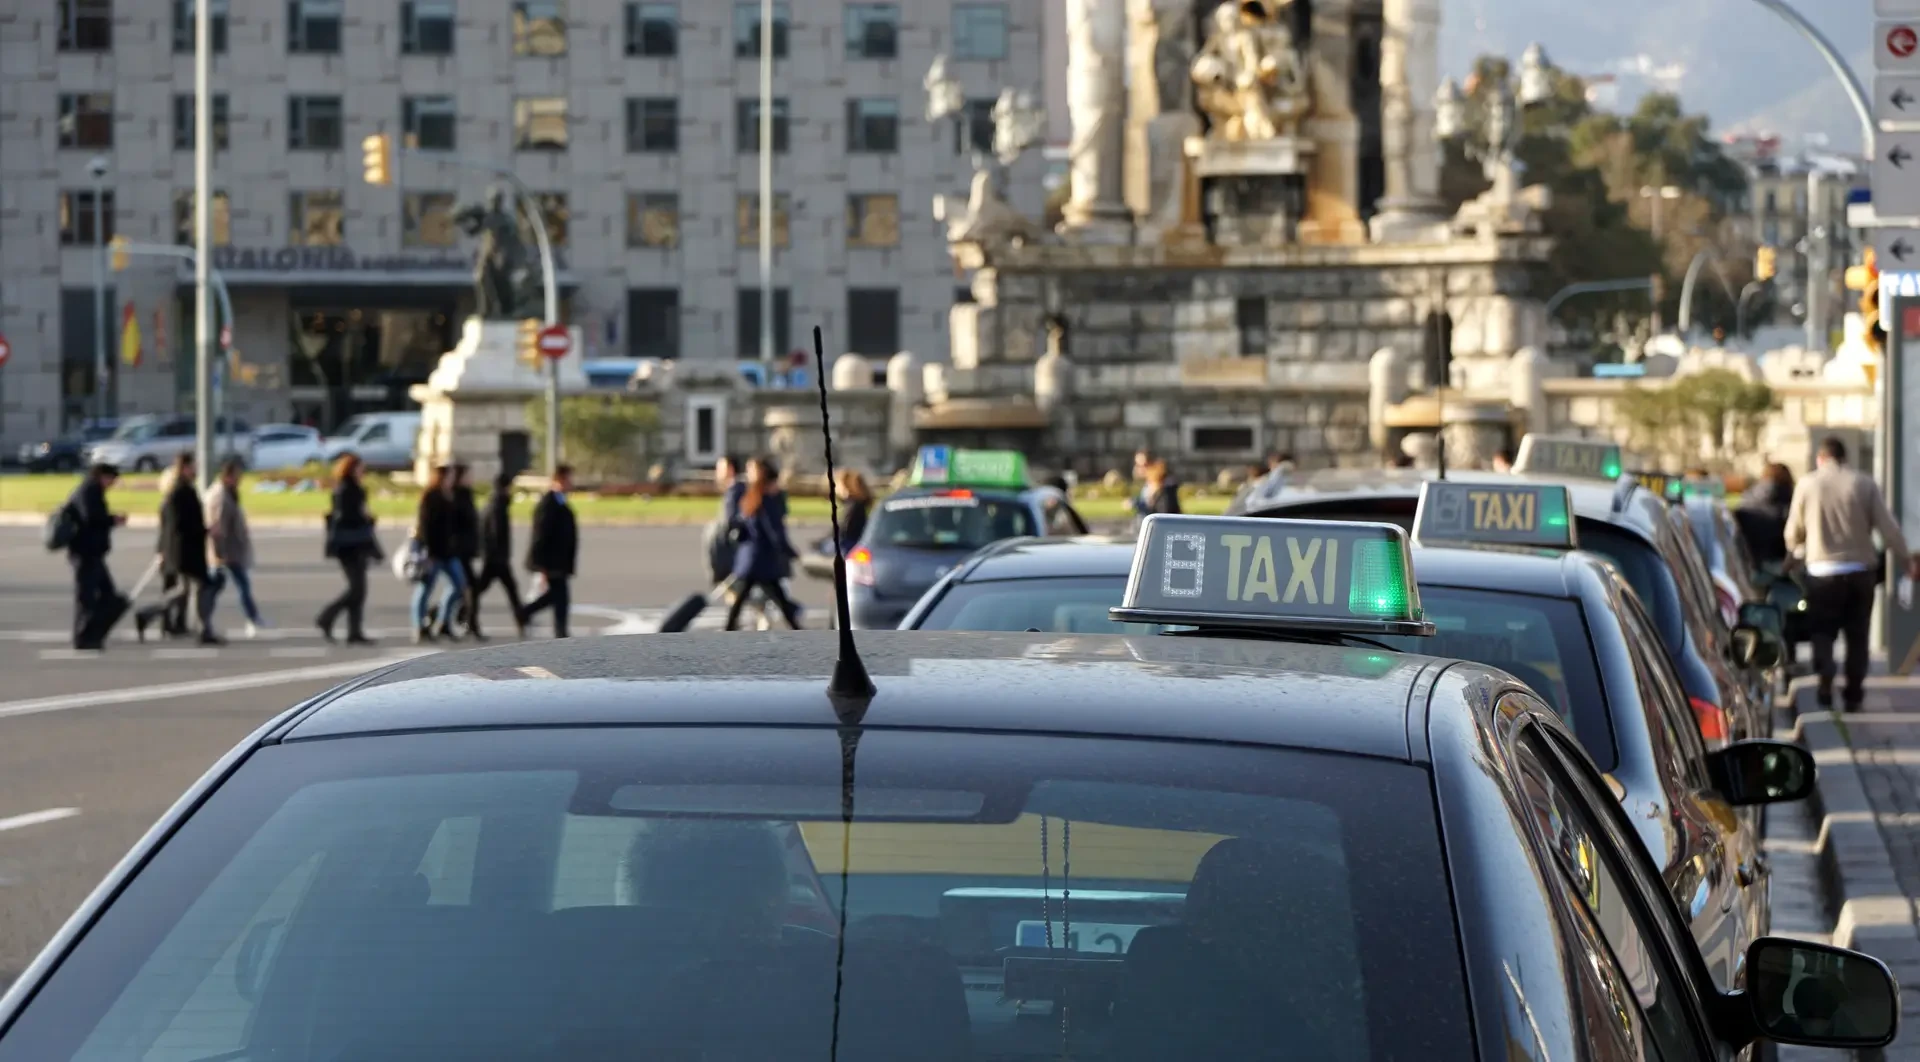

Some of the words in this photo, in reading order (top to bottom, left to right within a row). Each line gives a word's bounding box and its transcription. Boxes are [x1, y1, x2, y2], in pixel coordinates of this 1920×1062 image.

[1555, 445, 1600, 473] TAXI
[1469, 492, 1534, 530] TAXI
[1220, 534, 1338, 604] TAXI
